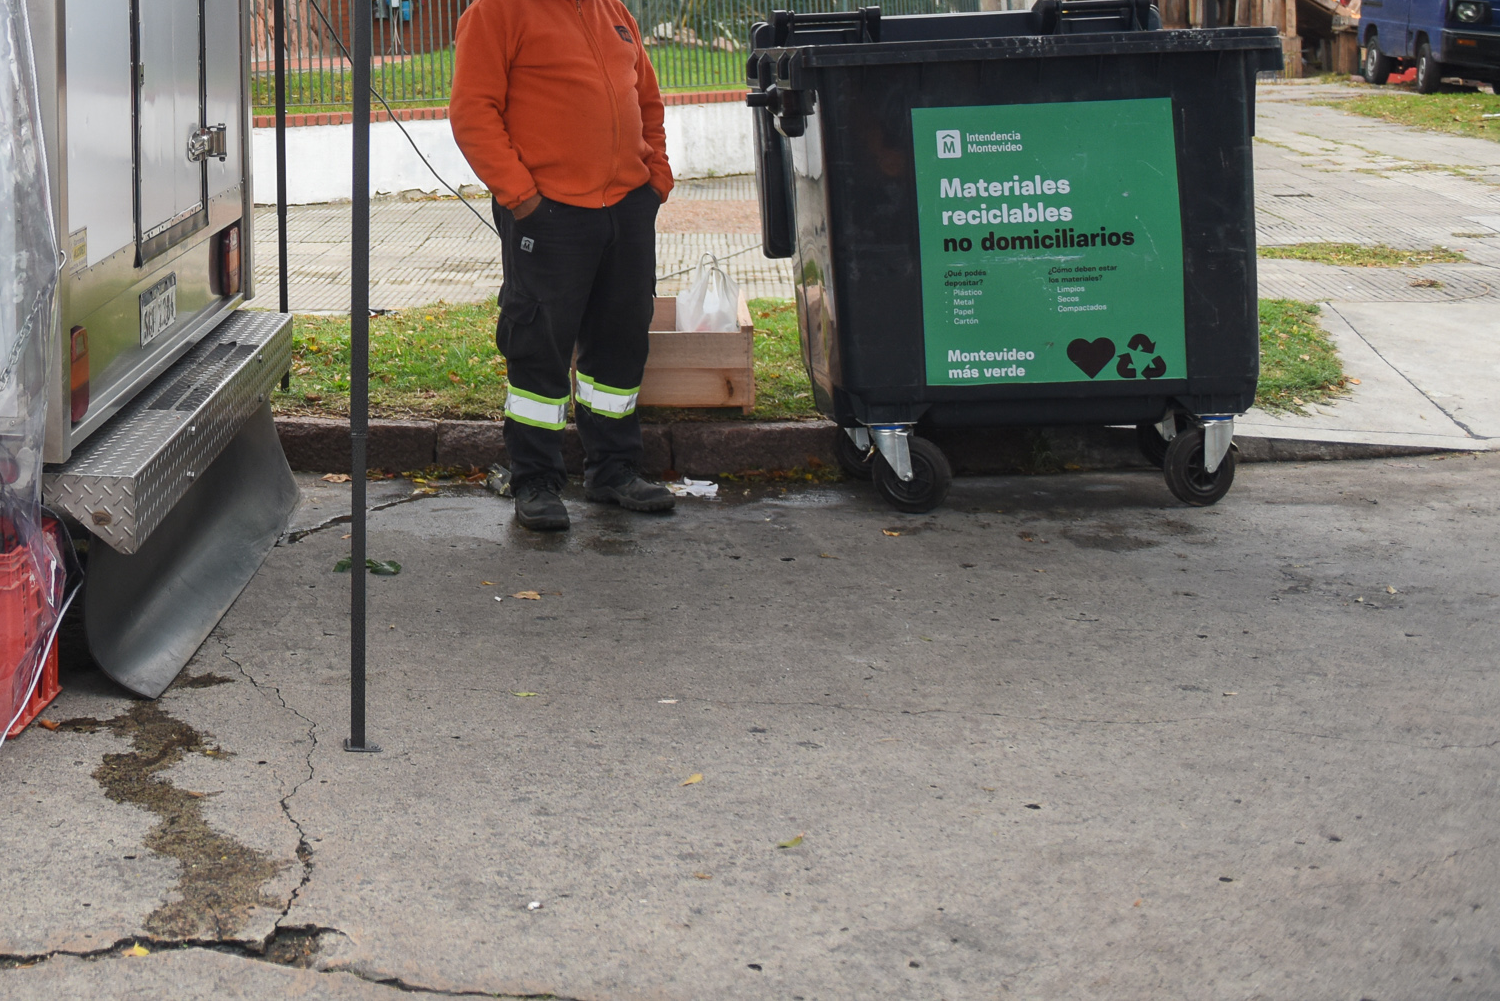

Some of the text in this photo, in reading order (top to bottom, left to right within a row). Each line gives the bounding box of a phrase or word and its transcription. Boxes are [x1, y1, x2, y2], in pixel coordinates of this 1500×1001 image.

[966, 131, 1021, 142] Intendencia
[967, 142, 1023, 153] Montevideo
[940, 175, 1070, 198] Materiales
[942, 202, 1072, 225] reciclables
[943, 226, 1135, 252] no domiciliarios
[944, 269, 986, 278] ¿Qué podés
[1048, 267, 1073, 275] ¿Cómo
[944, 278, 983, 288] depositar?
[1061, 274, 1103, 283] materiales?
[1057, 285, 1085, 293] Limpios
[1057, 304, 1107, 312] Compactados
[948, 349, 1035, 362] Montevideo
[948, 365, 1026, 378] más verde
